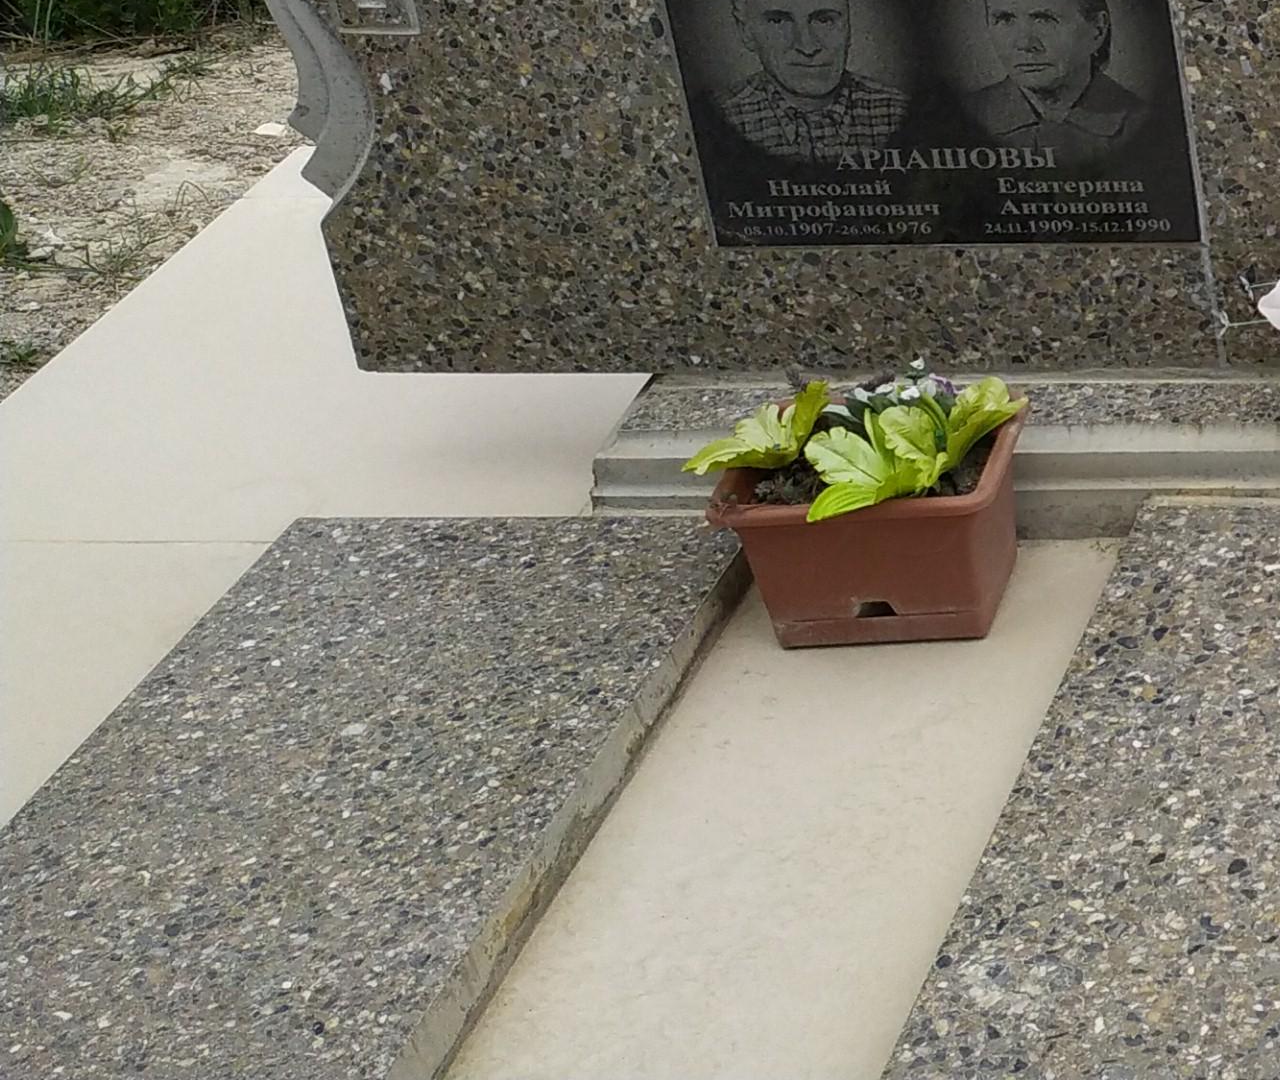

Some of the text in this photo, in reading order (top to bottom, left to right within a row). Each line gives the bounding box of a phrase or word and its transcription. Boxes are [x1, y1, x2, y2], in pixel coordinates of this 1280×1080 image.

[836, 146, 1058, 175] АРДАШОВЫ
[767, 178, 893, 197] Николай
[996, 176, 1145, 198] Екатерина
[727, 200, 941, 222] Митрофанович
[1000, 199, 1149, 216] Антоновна
[984, 218, 1173, 235] 24.11.1909-15.12.1990
